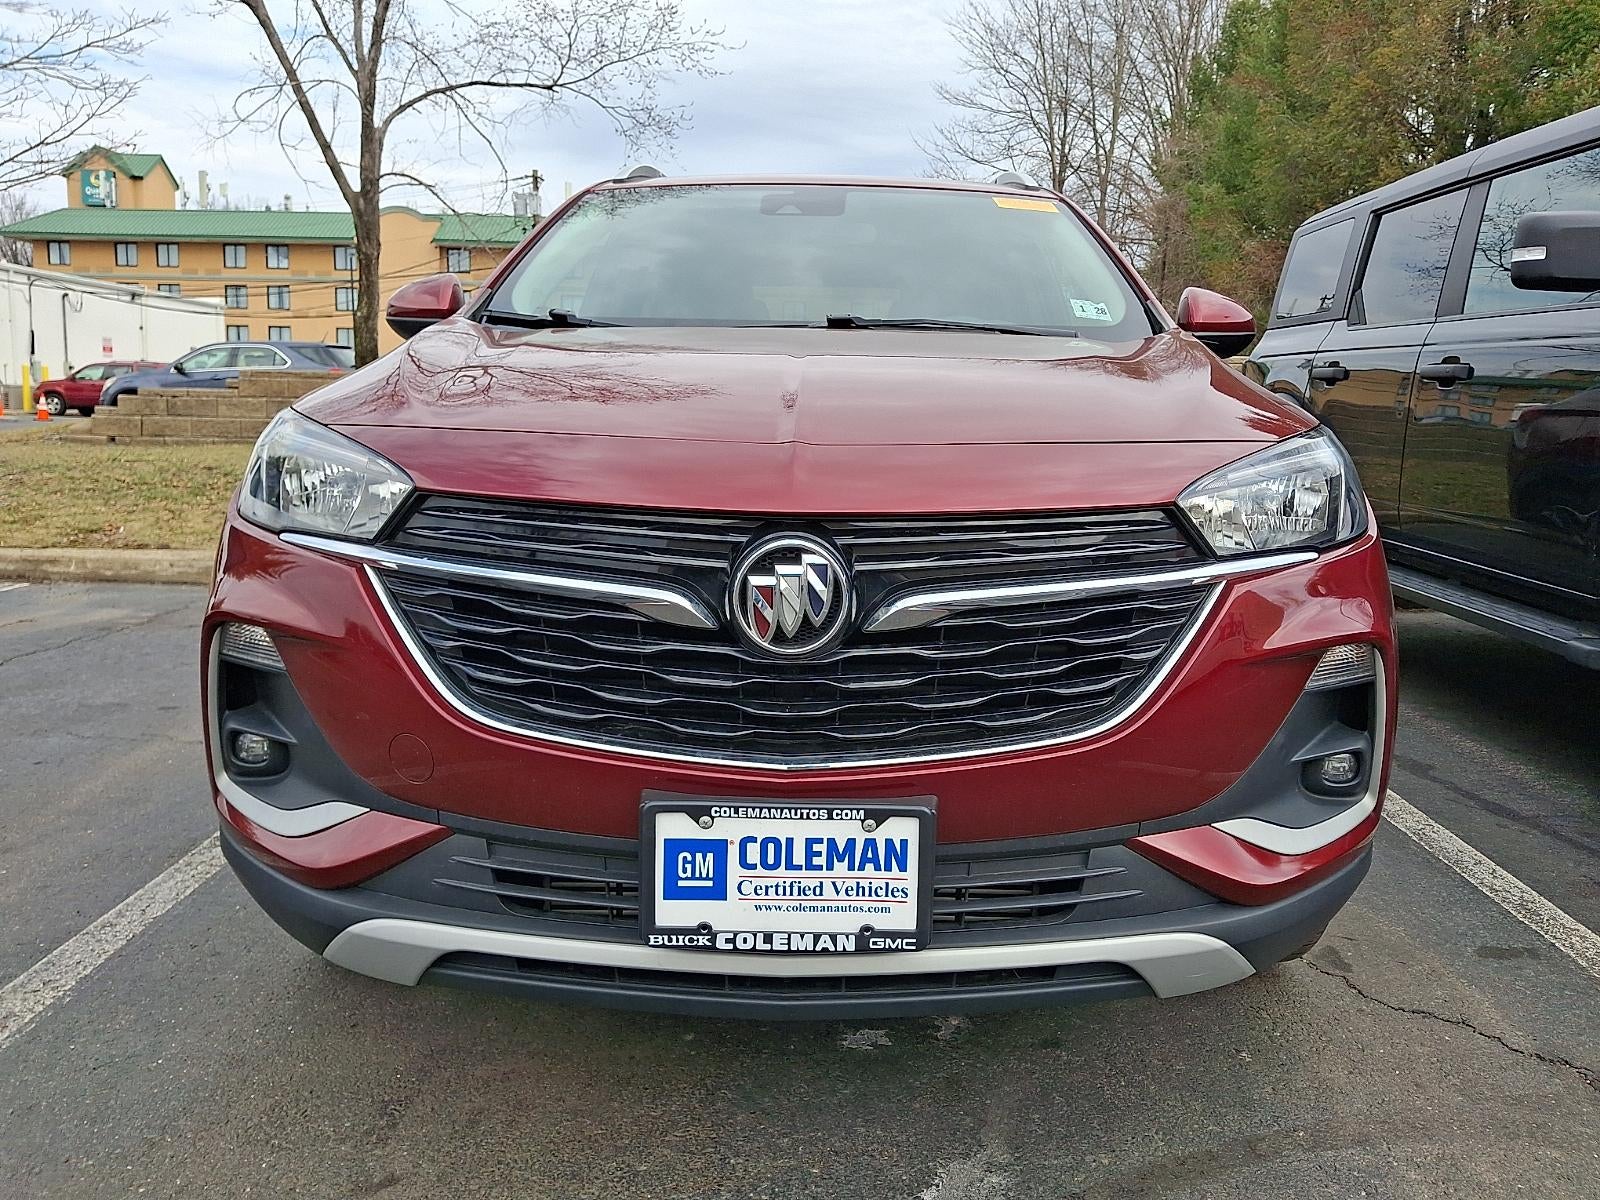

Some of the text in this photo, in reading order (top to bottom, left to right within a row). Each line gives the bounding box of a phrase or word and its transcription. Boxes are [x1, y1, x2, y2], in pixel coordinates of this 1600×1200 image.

[710, 806, 829, 821] COLEMANAUTOS
[738, 836, 909, 872] COLEMAN
[677, 851, 714, 878] GM
[736, 879, 909, 900] Certified Vehicles
[754, 903, 891, 914] www.colemanautos.com
[648, 932, 917, 952] BUICK COLEMAN GMC
